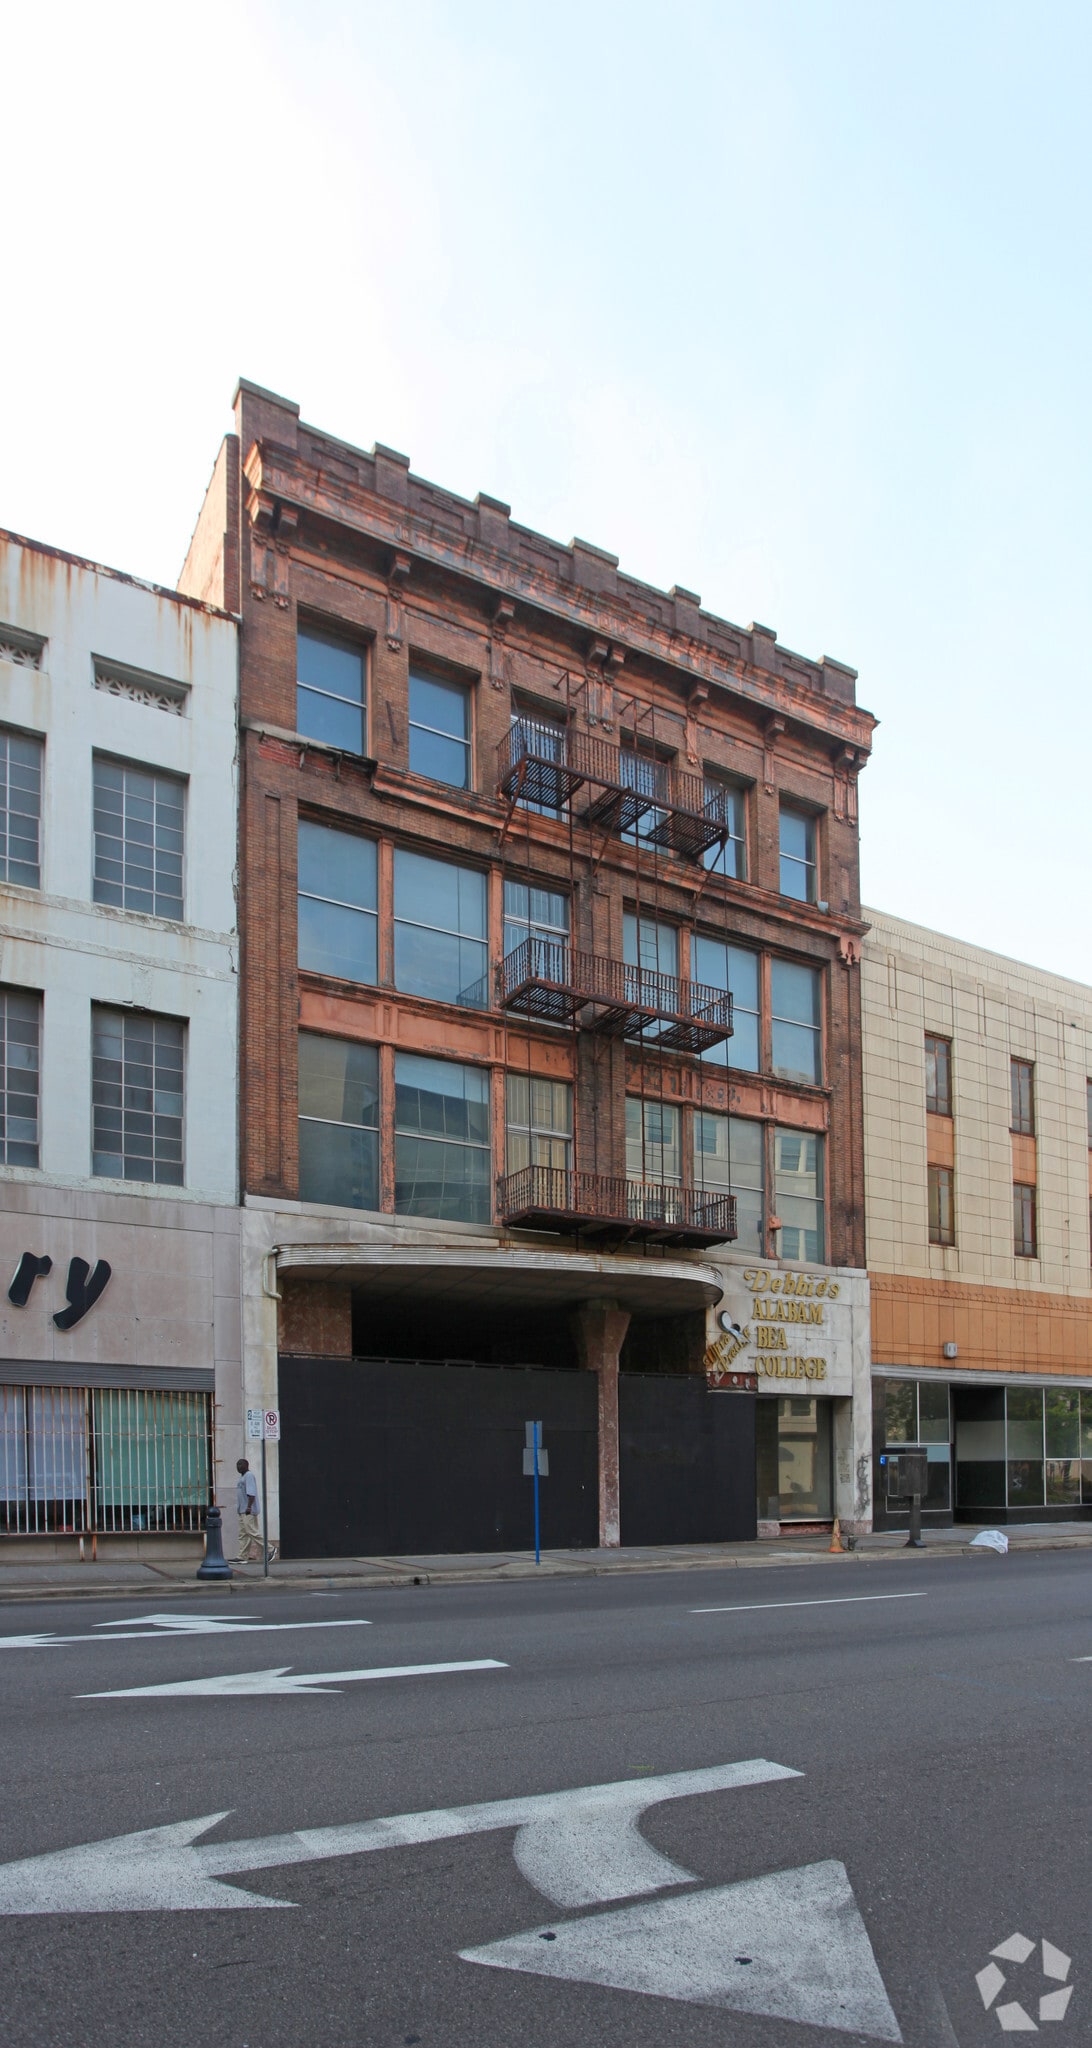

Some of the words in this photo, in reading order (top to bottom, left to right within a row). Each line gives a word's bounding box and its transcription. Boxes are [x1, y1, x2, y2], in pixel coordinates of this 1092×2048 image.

[8, 1251, 112, 1331] ry
[744, 1268, 840, 1299] Debbie's
[752, 1298, 824, 1325] ALABAM
[756, 1325, 789, 1350] BEA
[755, 1355, 827, 1380] COLLEGE
